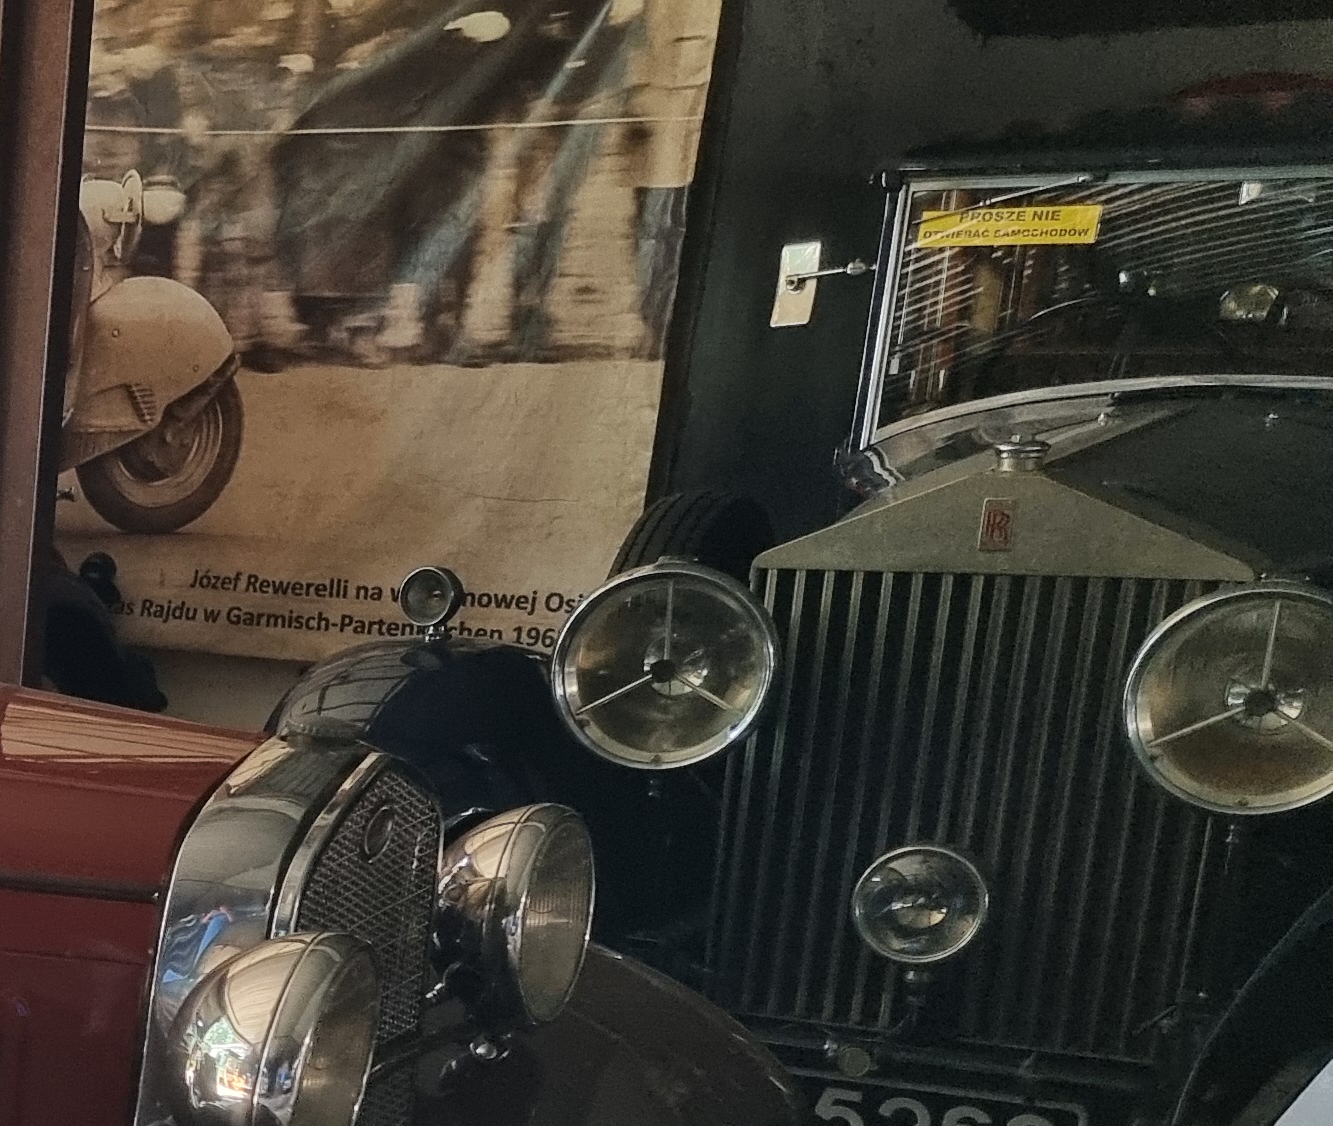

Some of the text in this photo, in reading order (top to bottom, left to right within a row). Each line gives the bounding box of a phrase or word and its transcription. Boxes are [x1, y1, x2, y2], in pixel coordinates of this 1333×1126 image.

[1031, 209, 1061, 222] NIE
[189, 569, 243, 592] Józef
[245, 573, 348, 600] Rewerelli
[355, 584, 383, 601] na
[140, 599, 198, 624] Rajdu
[203, 608, 220, 624] w
[512, 625, 562, 649] 196
